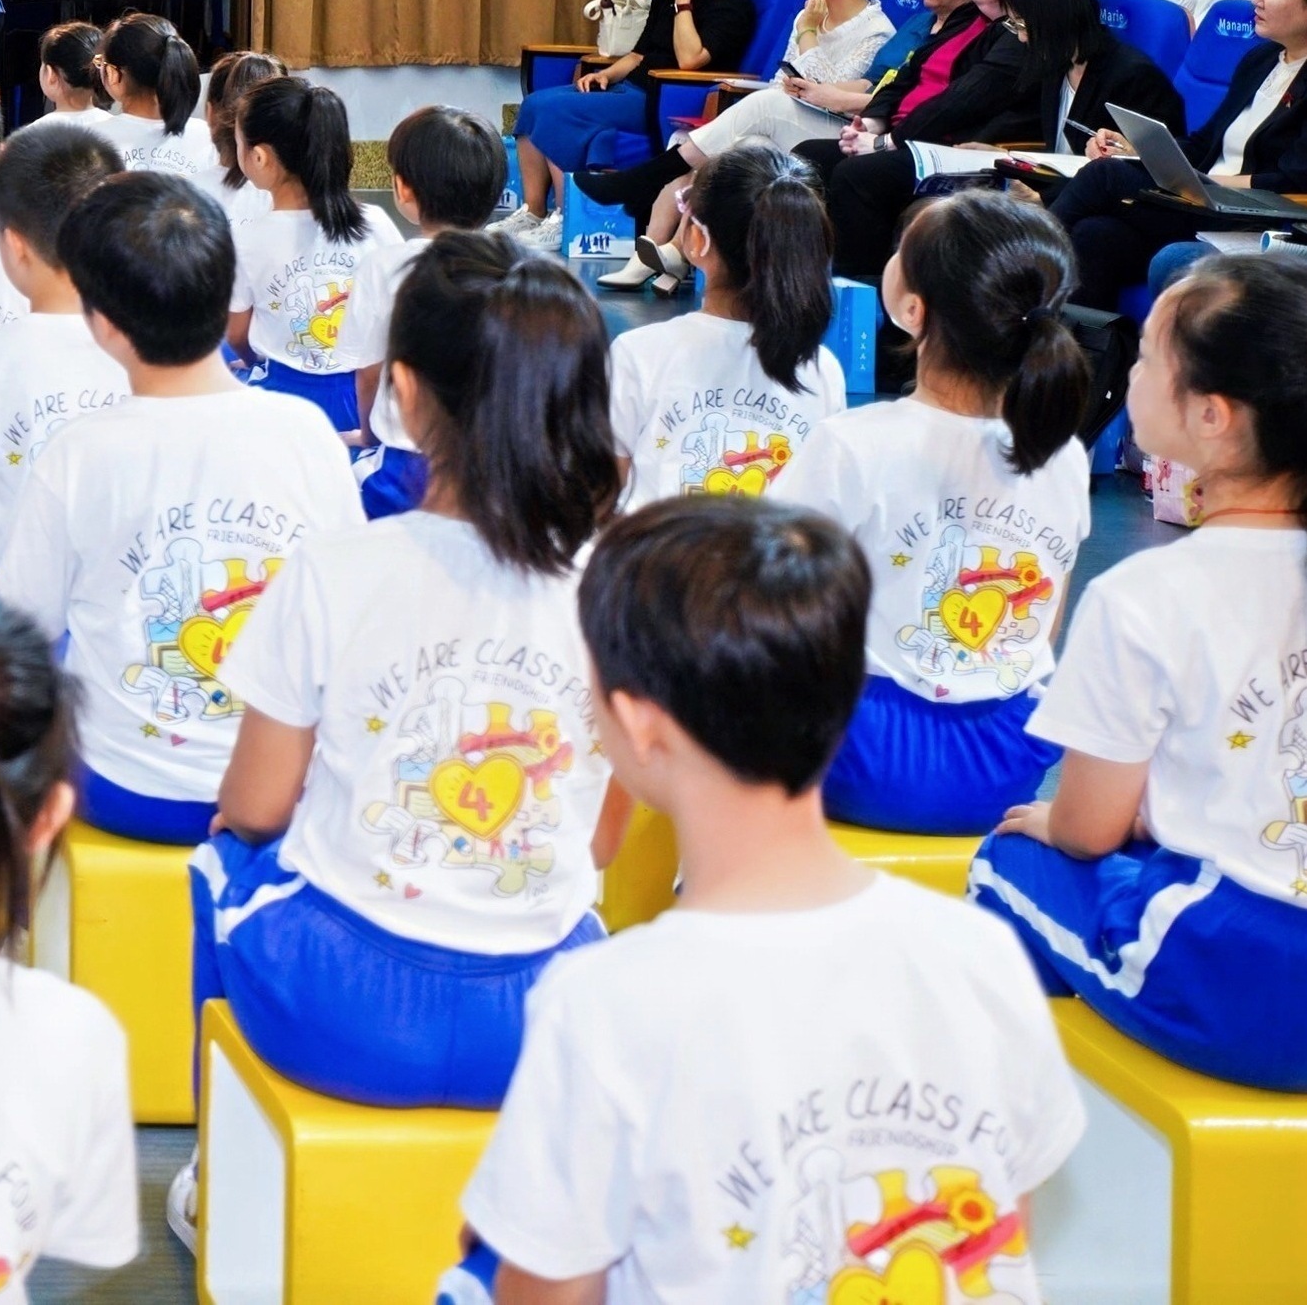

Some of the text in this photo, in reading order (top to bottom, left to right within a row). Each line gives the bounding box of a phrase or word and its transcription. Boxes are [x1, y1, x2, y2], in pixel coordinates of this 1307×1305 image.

[1100, 8, 1124, 23] Marie
[1219, 18, 1253, 32] Manami
[124, 147, 198, 174] ARE CLASS FO
[265, 252, 355, 298] WE ARE CLASS
[2, 390, 69, 447] WE ARE
[659, 388, 790, 433] WE ARE CLASS
[731, 408, 783, 432] FRIENDSHIP
[119, 497, 288, 575] WE ARE CLASS
[206, 530, 283, 555] FRIENDSHIP
[895, 497, 1074, 571] WE CLASS FOUR
[971, 520, 1032, 549] FRIENDSHIP
[958, 606, 984, 638] 4
[368, 662, 409, 711] WE
[416, 639, 462, 683] ARE
[475, 638, 563, 687] CLASS
[1230, 677, 1276, 724] WE
[457, 781, 495, 822] 4
[716, 1140, 774, 1212] WE
[845, 1077, 964, 1132] CLASS
